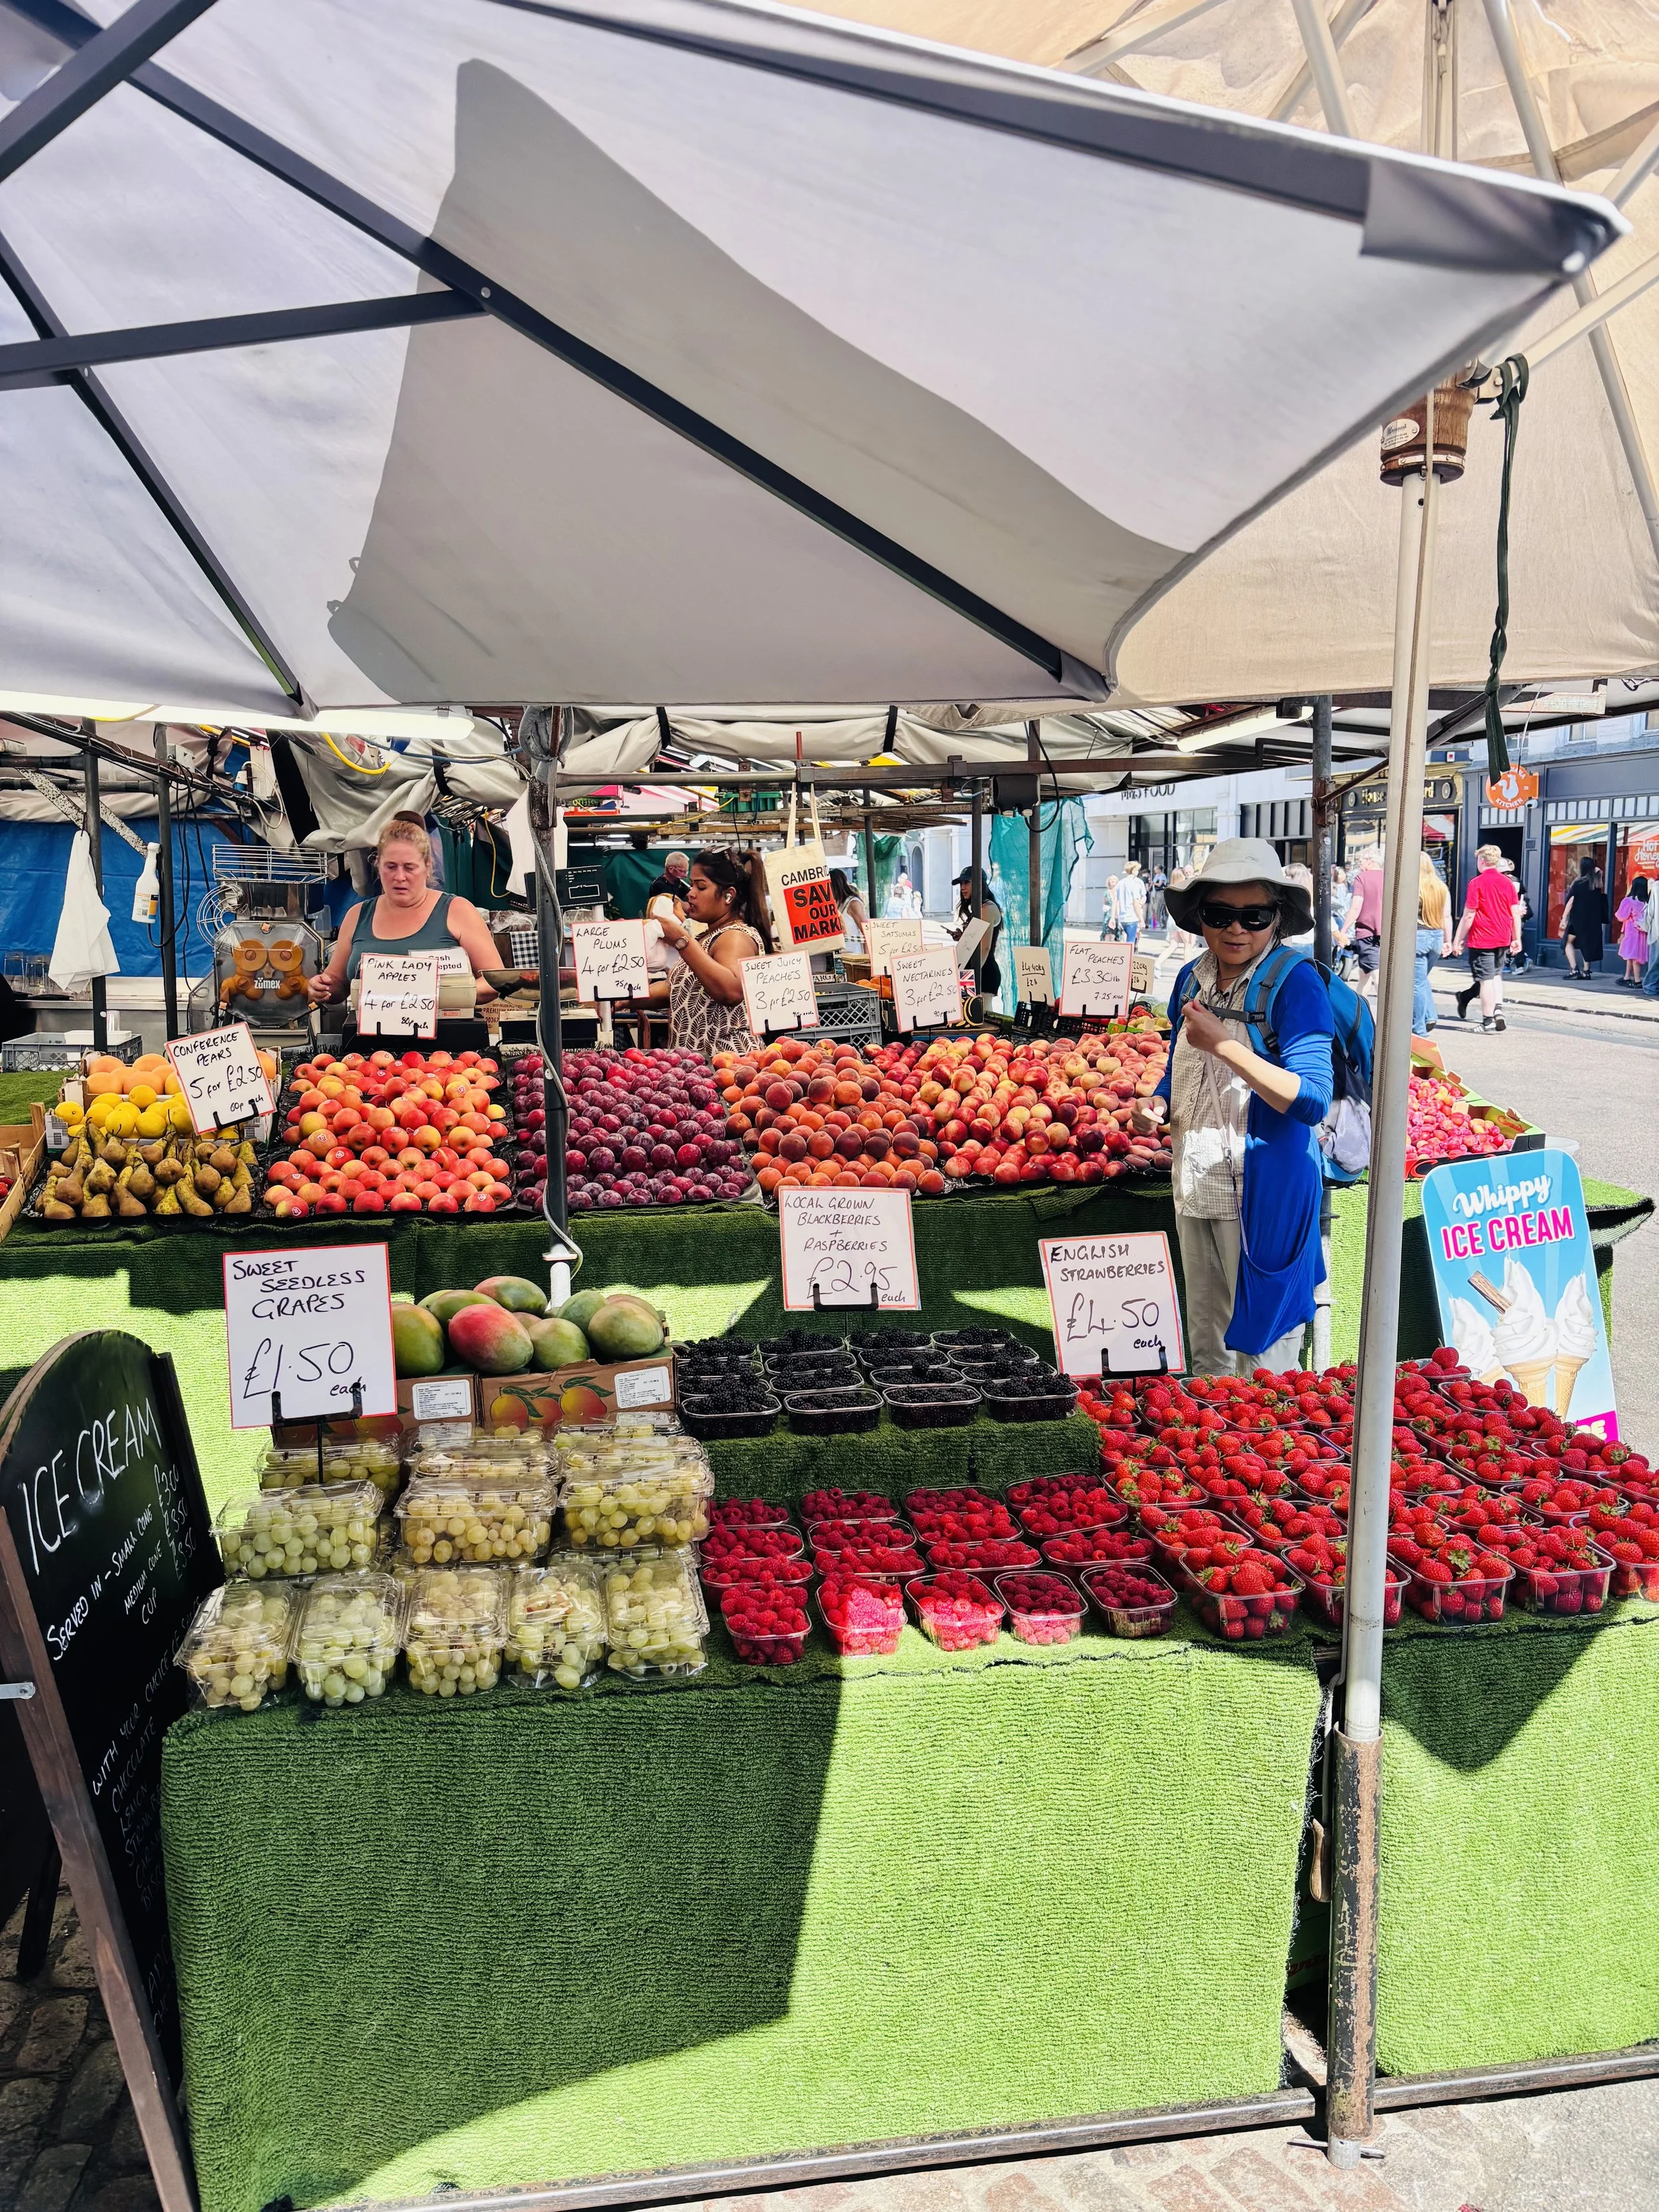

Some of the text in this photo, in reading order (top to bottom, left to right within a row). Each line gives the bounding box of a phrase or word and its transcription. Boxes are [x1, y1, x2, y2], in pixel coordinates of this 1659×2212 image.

[1495, 797, 1524, 808] KITCHEN
[781, 865, 830, 886] CAMBRID
[793, 881, 835, 908] SAV
[810, 904, 837, 920] OUR
[576, 927, 610, 937] LARGE
[794, 917, 842, 941] MARK
[593, 938, 627, 949] PLUMS
[879, 943, 890, 955] 5
[890, 948, 899, 956] for
[1070, 944, 1092, 956] FLAT
[366, 958, 432, 971] PINK LADY
[581, 954, 644, 976] 4 for £2.50
[745, 957, 802, 972] SWEET JUICY
[897, 959, 926, 971] SWEET
[1088, 954, 1125, 965] PEACHES
[378, 972, 417, 982] APPLES
[757, 970, 801, 984] PEACHES
[902, 968, 953, 982] NECTARINES
[364, 990, 377, 1009] 4
[382, 1001, 396, 1011] for
[755, 991, 767, 1009] 3
[770, 997, 780, 1010] for
[904, 989, 916, 1005] 3
[916, 994, 926, 1007] for
[173, 1032, 239, 1057] CONFERENCE
[196, 1047, 232, 1067] PEARS
[190, 1065, 263, 1099] 5 for £2.50
[784, 1195, 875, 1209] LOCAL GROWN
[1453, 1173, 1552, 1218] Whippy
[797, 1212, 881, 1226] BLACKBERRIES
[1440, 1205, 1575, 1262] ICE CREAM
[804, 1237, 888, 1251] RASPBERRIES
[1050, 1244, 1129, 1263] ENGLISH
[233, 1260, 299, 1280] SWEET
[807, 1256, 897, 1299] £2.95
[1060, 1260, 1165, 1282] STRAWBERRIES
[259, 1270, 366, 1293] SEEDLESS
[252, 1293, 345, 1319] GRAPES
[881, 1290, 905, 1302] each
[1066, 1292, 1159, 1342] £4.50
[1133, 1335, 1163, 1349] each
[243, 1337, 354, 1399] £1.50
[23, 1398, 162, 1576] ICE CREAM
[47, 1596, 89, 1660] SERVED
[92, 1575, 101, 1600] IN
[111, 1531, 137, 1577] SMALL
[137, 1503, 153, 1536] CONE
[123, 1570, 148, 1615] MEDIUM
[148, 1540, 162, 1571] CONE
[142, 1587, 157, 1625] CUP
[92, 1739, 119, 1796] WITH
